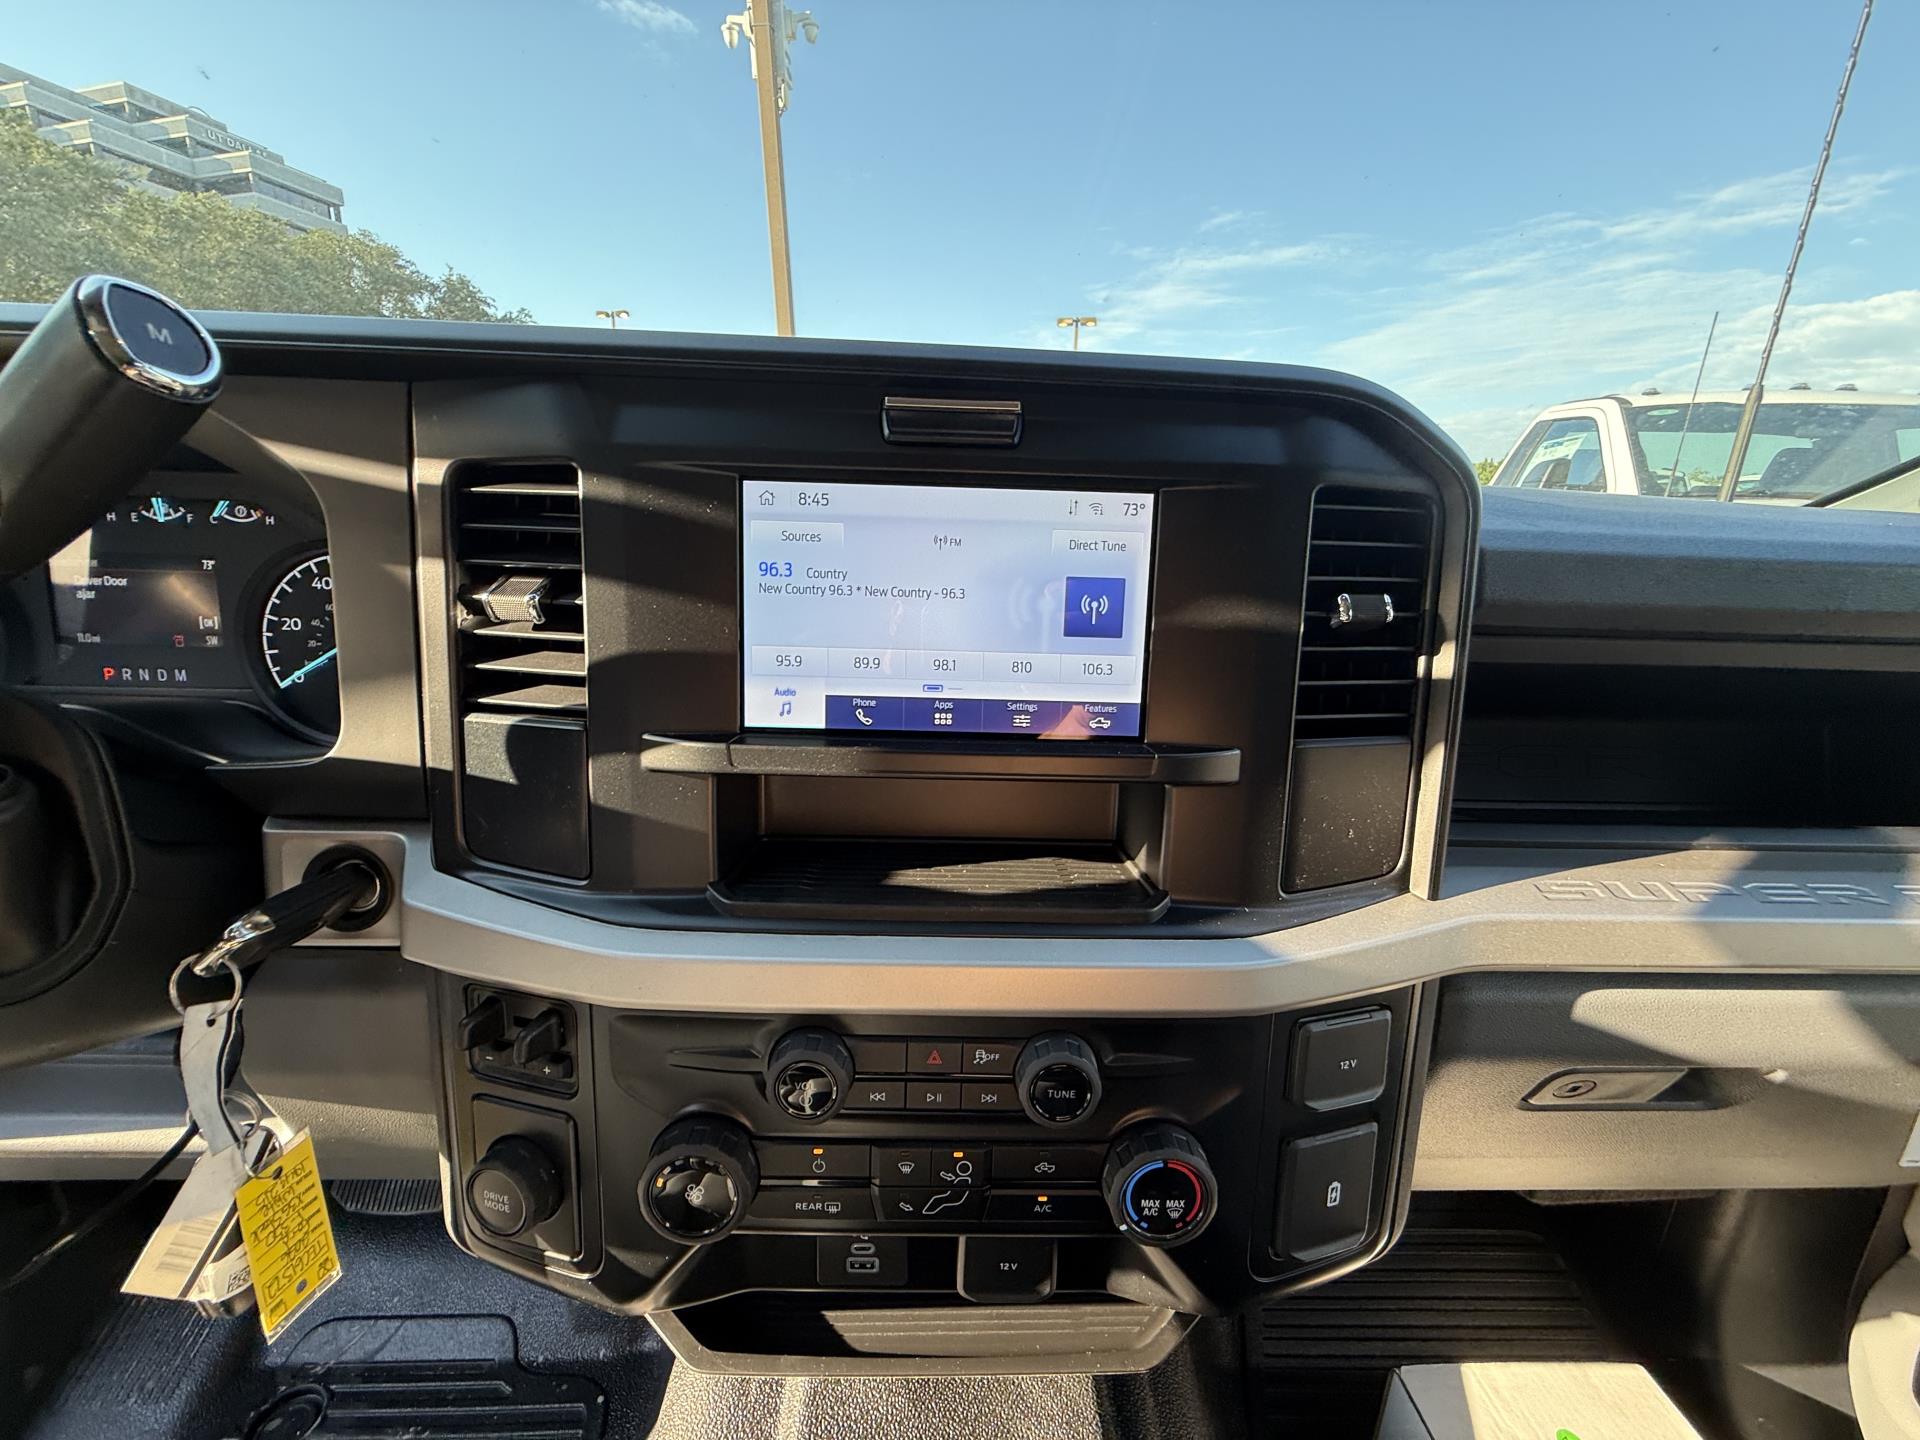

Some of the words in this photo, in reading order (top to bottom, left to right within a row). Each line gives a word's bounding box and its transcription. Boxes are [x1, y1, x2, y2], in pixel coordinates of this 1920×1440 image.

[207, 129, 224, 142] UT
[145, 322, 173, 345] M
[798, 491, 829, 507] 8:45
[1122, 502, 1146, 517] 73°
[106, 511, 116, 521] H
[130, 512, 139, 522] E
[186, 513, 195, 523] F
[265, 515, 275, 525] H
[781, 530, 822, 543] Sources
[949, 538, 962, 547] FM
[1069, 538, 1098, 551] Direct
[1101, 540, 1127, 552] Tune
[758, 561, 793, 578] 96.3
[806, 567, 848, 581] Country
[103, 575, 129, 586] Door
[311, 576, 333, 590] 40
[76, 588, 96, 600] ajar
[758, 582, 782, 594] New
[785, 583, 826, 597] Country
[828, 584, 853, 597] 96.3
[864, 585, 888, 597] New
[890, 586, 931, 600] Country
[941, 587, 965, 600] 96.3
[280, 617, 302, 631] 20
[205, 635, 218, 646] SW
[775, 654, 802, 668] 95.9
[853, 656, 881, 669] 89.9
[932, 658, 957, 672] 98.1
[1011, 661, 1032, 674] 810
[1082, 663, 1113, 676] 106.3
[103, 667, 114, 680] P
[122, 668, 132, 681] R
[139, 668, 150, 681] N
[157, 668, 168, 681] D
[174, 669, 187, 682] M
[774, 687, 797, 697] Audio
[852, 698, 877, 707] Phone
[934, 700, 954, 709] Apps
[1006, 702, 1038, 712] Settings
[1084, 704, 1118, 713] Features
[1534, 880, 1890, 906] SUPER
[984, 1053, 1000, 1061] OFF
[1340, 1060, 1350, 1070] 12
[1350, 1059, 1357, 1068] V
[1047, 1089, 1077, 1099] TUNE
[483, 1190, 510, 1204] DRIVE
[484, 1199, 511, 1213] MODE
[795, 1202, 823, 1211] REAR
[1033, 1204, 1053, 1213] A/C
[1140, 1199, 1161, 1208] MAX
[1165, 1199, 1186, 1208] MAX
[1142, 1207, 1159, 1216] A/C
[999, 1262, 1010, 1271] 12
[1011, 1262, 1018, 1271] V
